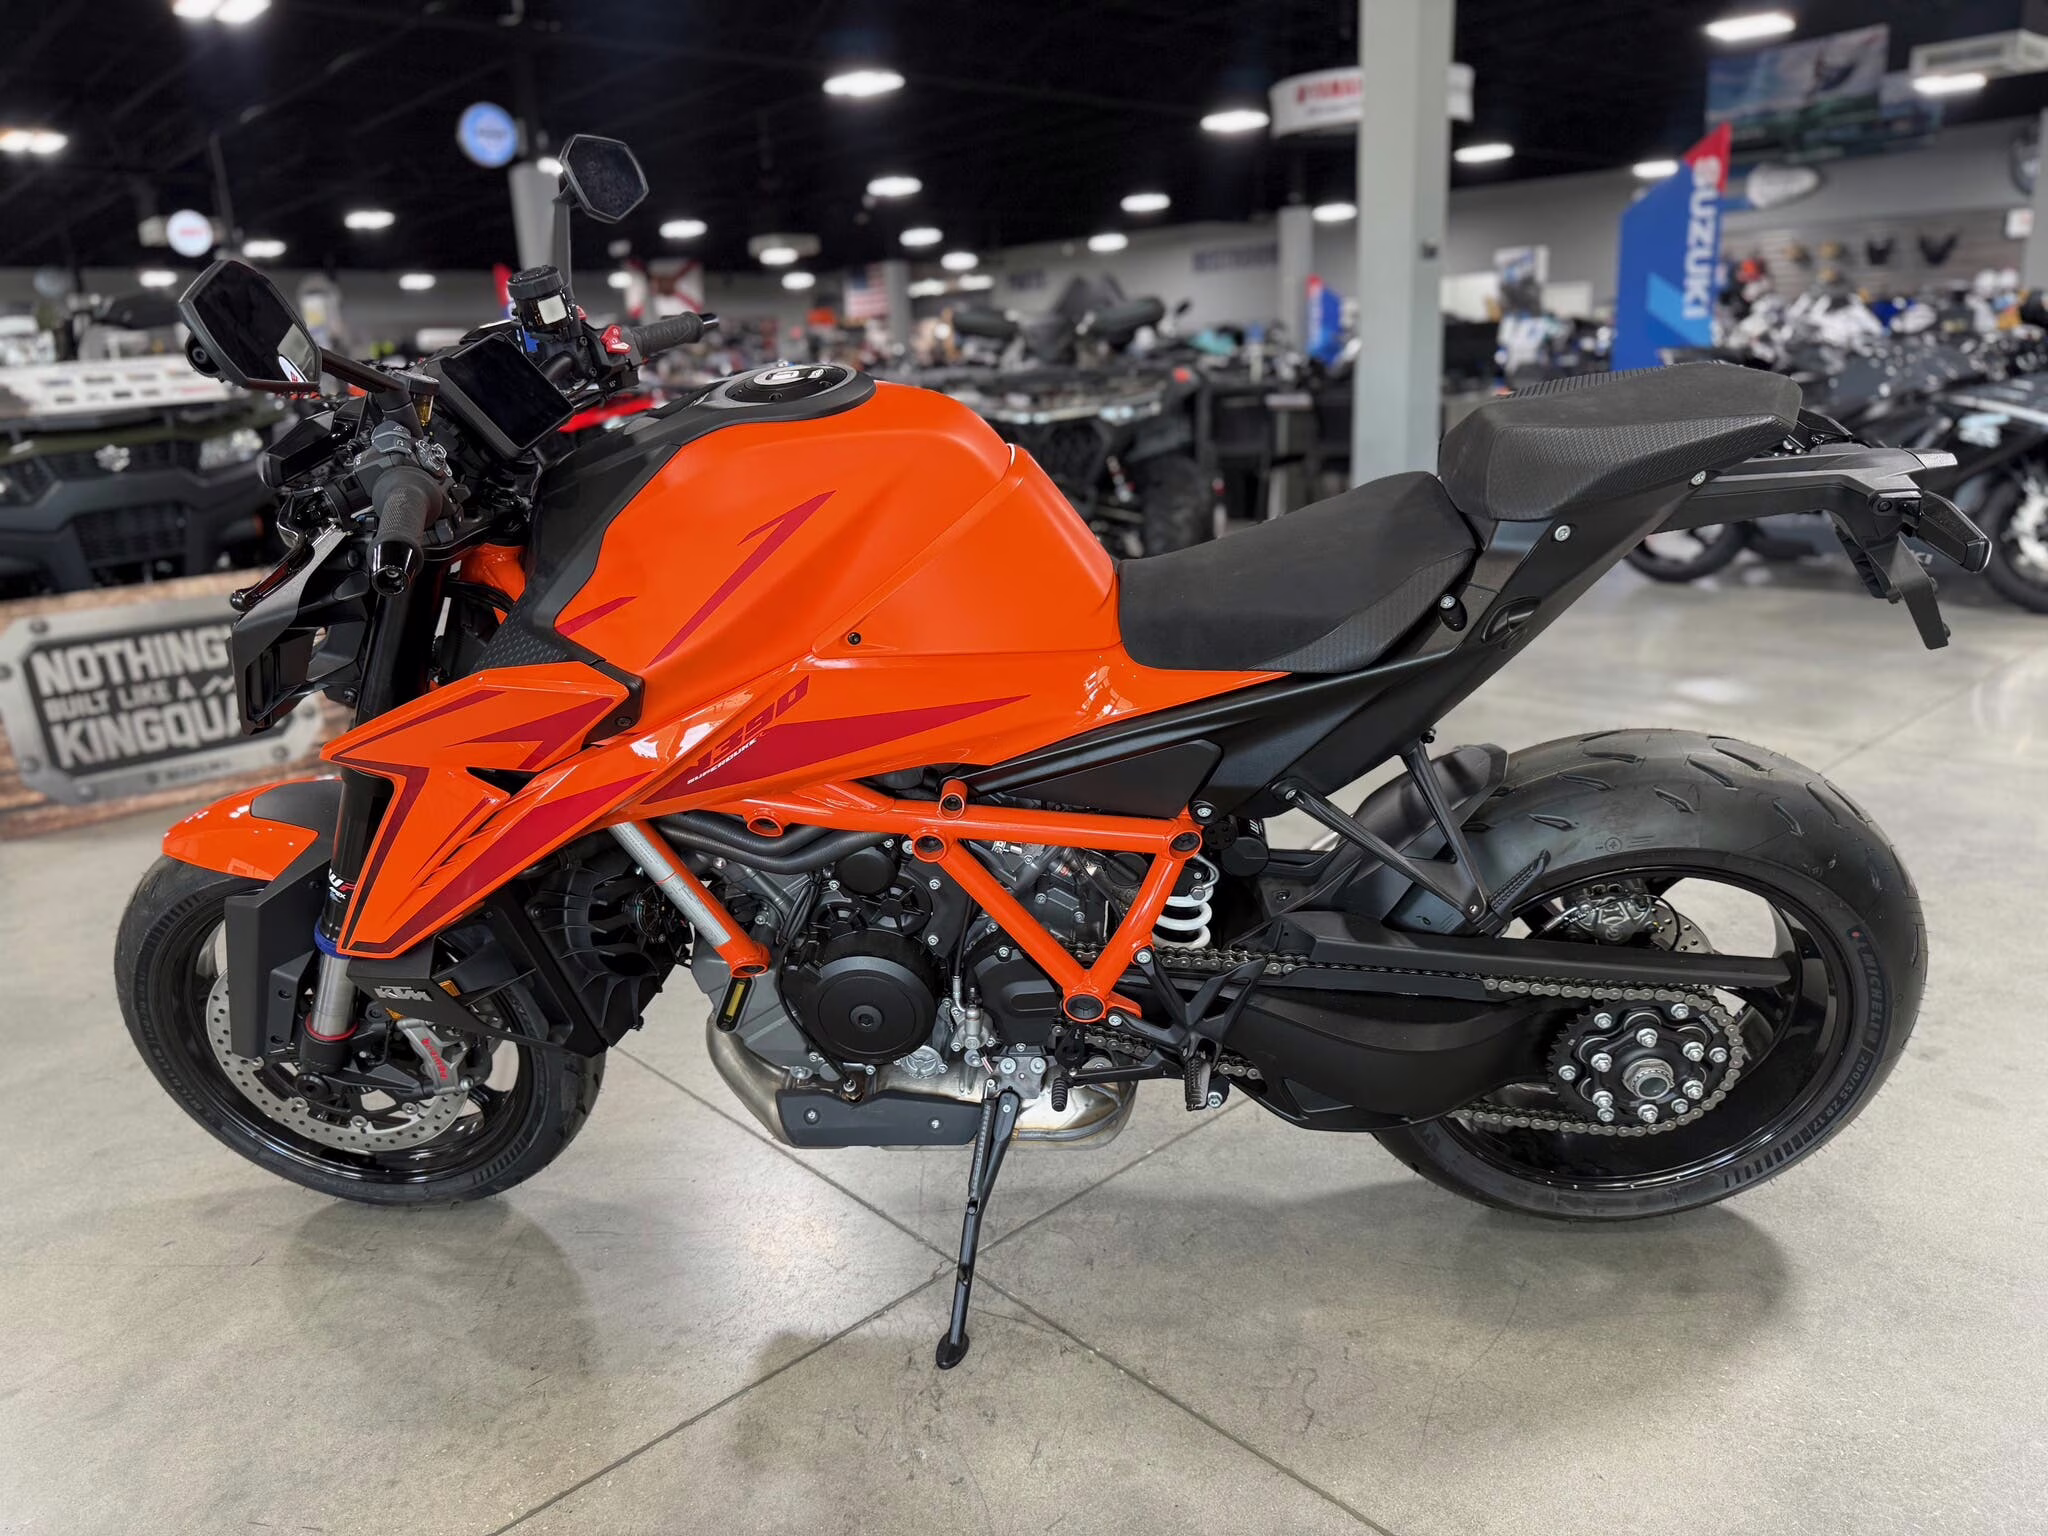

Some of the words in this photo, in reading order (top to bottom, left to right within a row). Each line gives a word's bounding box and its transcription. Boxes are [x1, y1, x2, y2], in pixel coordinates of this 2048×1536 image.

[1682, 155, 1721, 318] SUZUKI
[43, 689, 110, 722] BUILT
[117, 679, 172, 709] LIKE
[177, 675, 197, 700] A
[374, 985, 433, 1001] KTM
